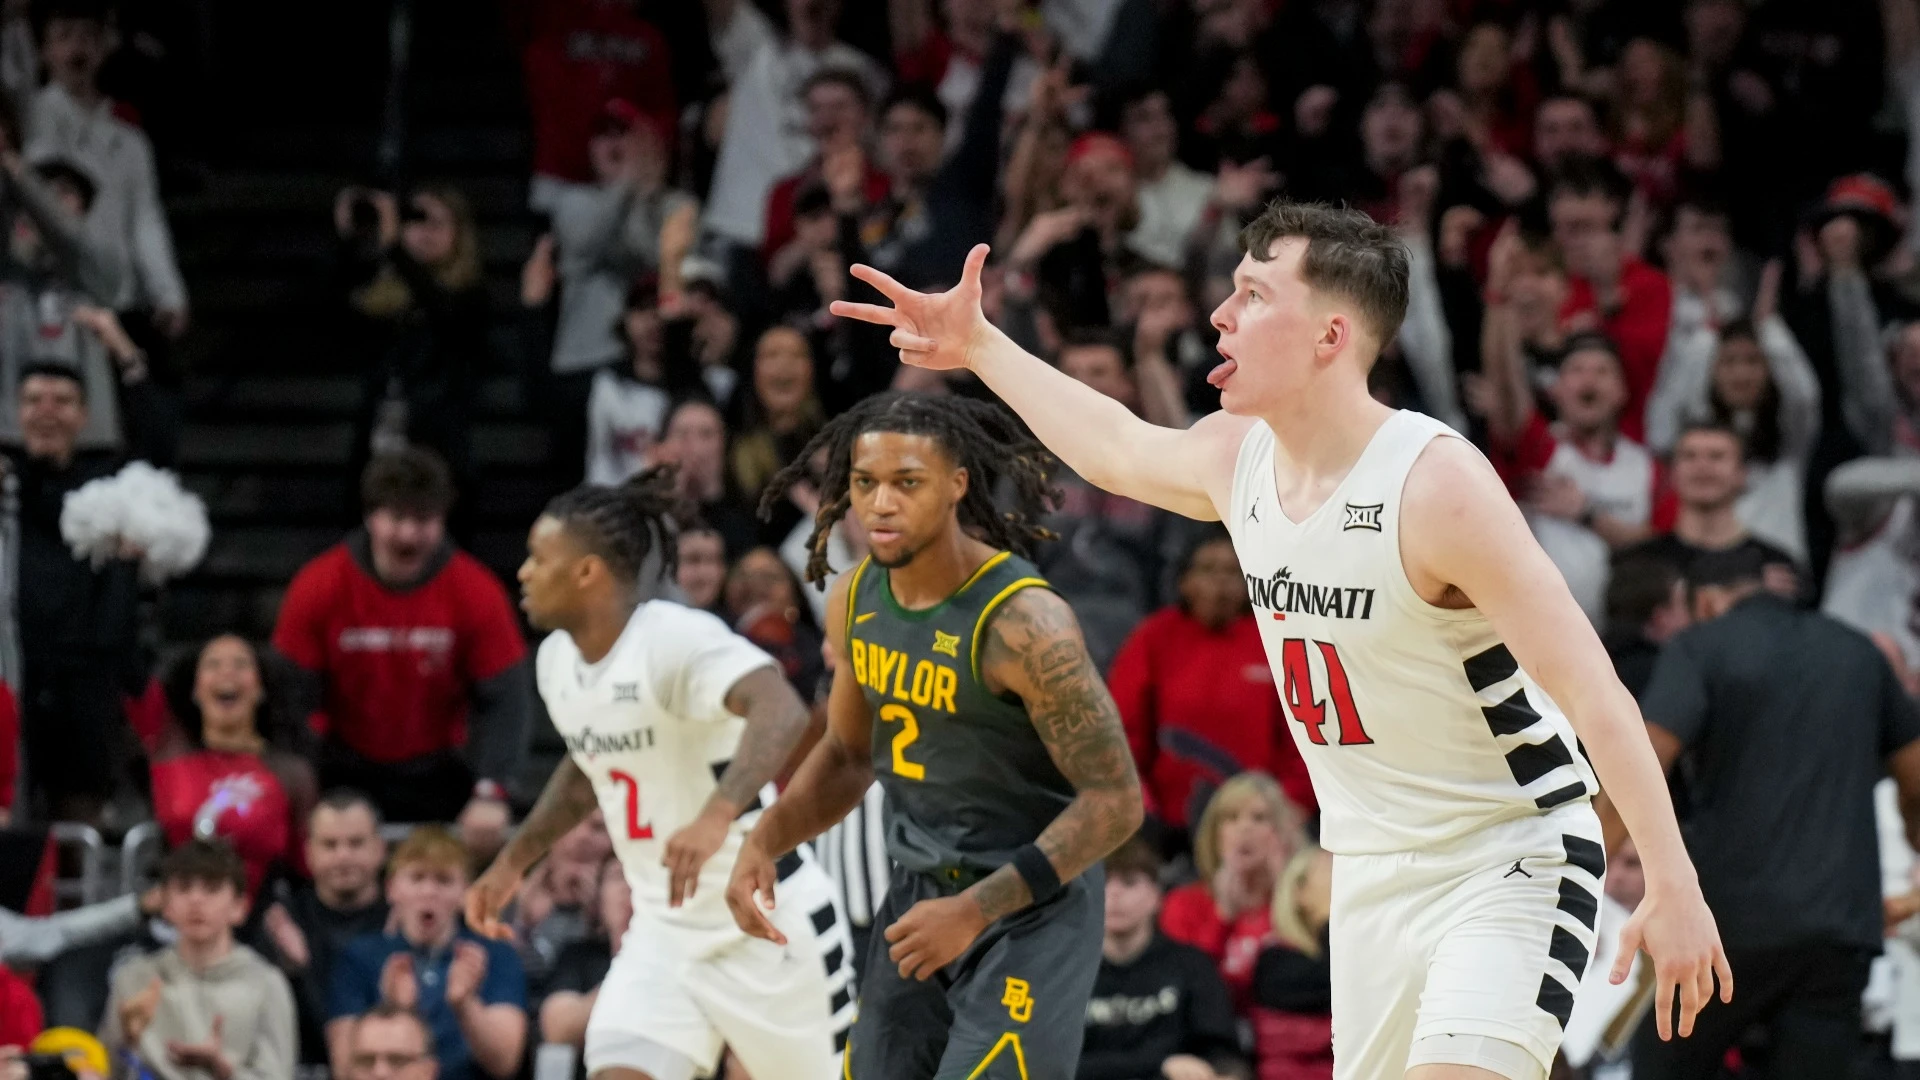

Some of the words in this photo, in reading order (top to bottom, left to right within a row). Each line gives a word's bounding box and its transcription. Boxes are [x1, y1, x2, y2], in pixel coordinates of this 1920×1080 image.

[851, 637, 958, 715] BAYLOR
[1281, 637, 1376, 746] 41
[879, 702, 926, 782] 2
[607, 768, 655, 840] 2
[1001, 975, 1035, 1023] BU
